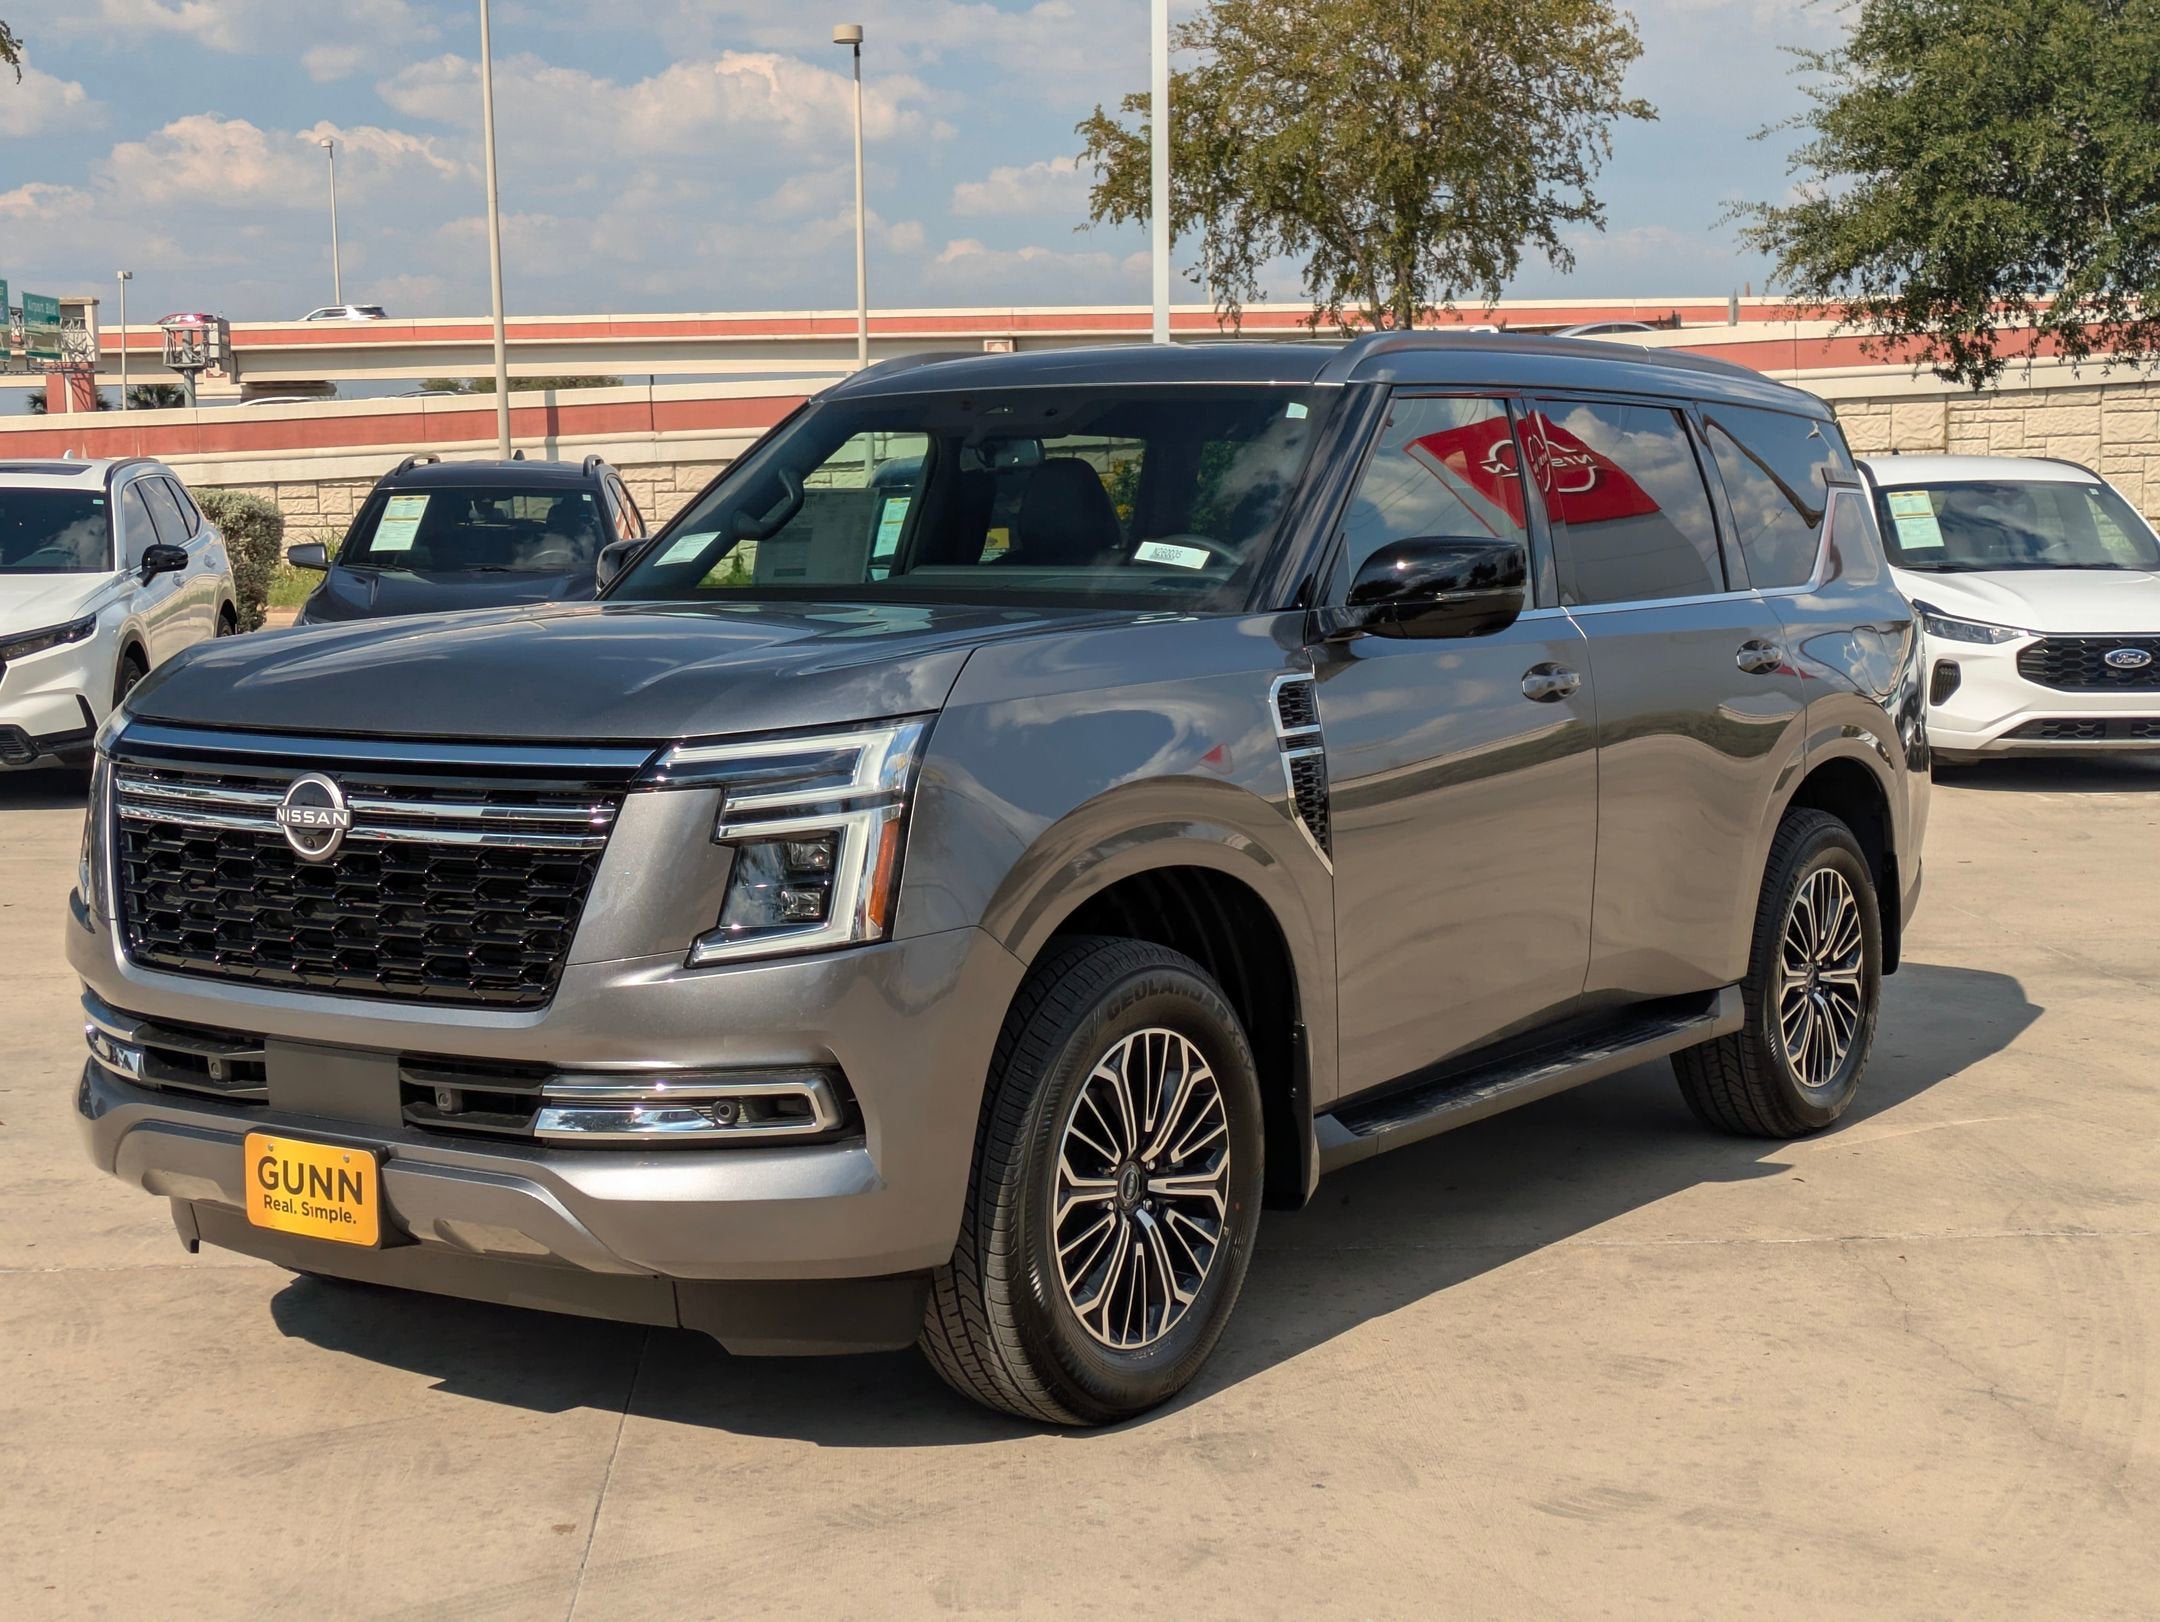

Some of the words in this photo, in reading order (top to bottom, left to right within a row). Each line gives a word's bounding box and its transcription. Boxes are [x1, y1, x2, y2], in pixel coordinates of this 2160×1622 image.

[2116, 652, 2142, 664] Ford
[276, 808, 347, 826] NISSAN
[257, 1155, 363, 1206] GUNN
[263, 1194, 297, 1215] Real.
[301, 1201, 357, 1225] Simple.
